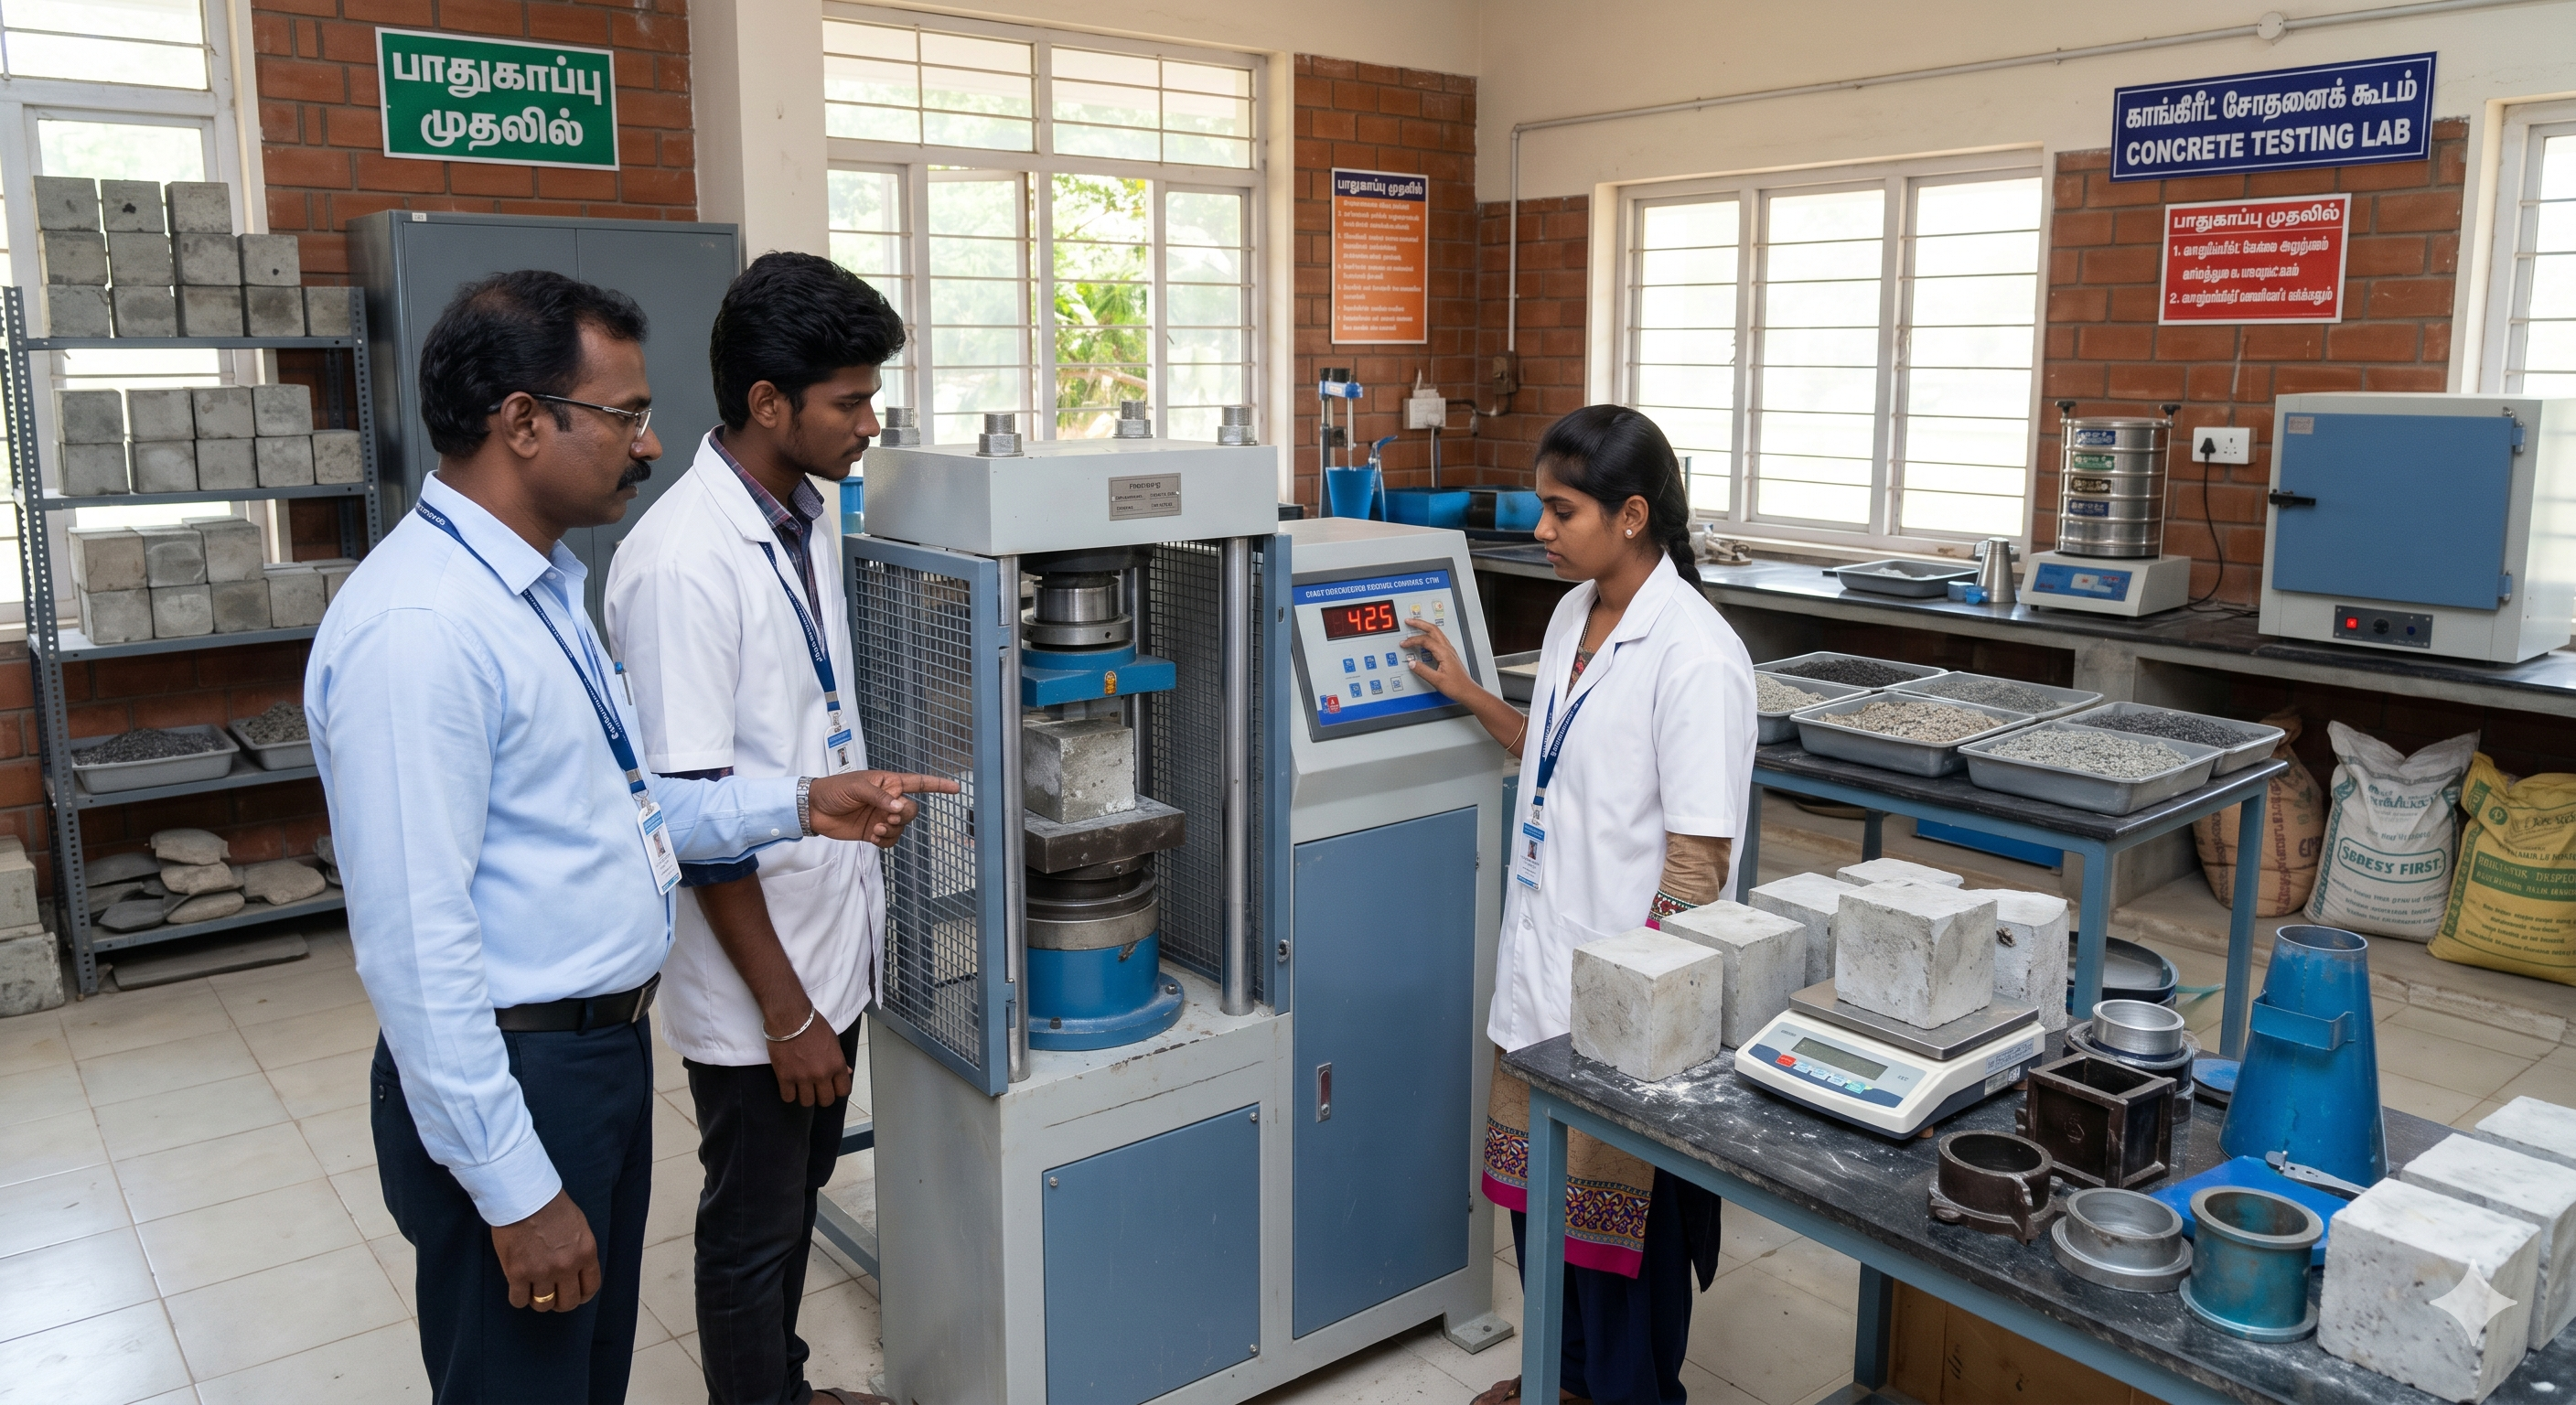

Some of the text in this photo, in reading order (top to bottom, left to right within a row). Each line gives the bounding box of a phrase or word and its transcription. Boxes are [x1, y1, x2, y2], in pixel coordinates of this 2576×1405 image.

[392, 52, 602, 105] பாதுகாப்பு
[2223, 78, 2346, 123] சோதனைக்
[2351, 70, 2417, 106] கூடம்
[421, 106, 584, 151] முதலில்
[2126, 118, 2410, 166] CONCRETE TESTING LAB
[2174, 202, 2339, 233] பாதுகாப்பு முதலில்
[1347, 605, 1393, 631] 425
